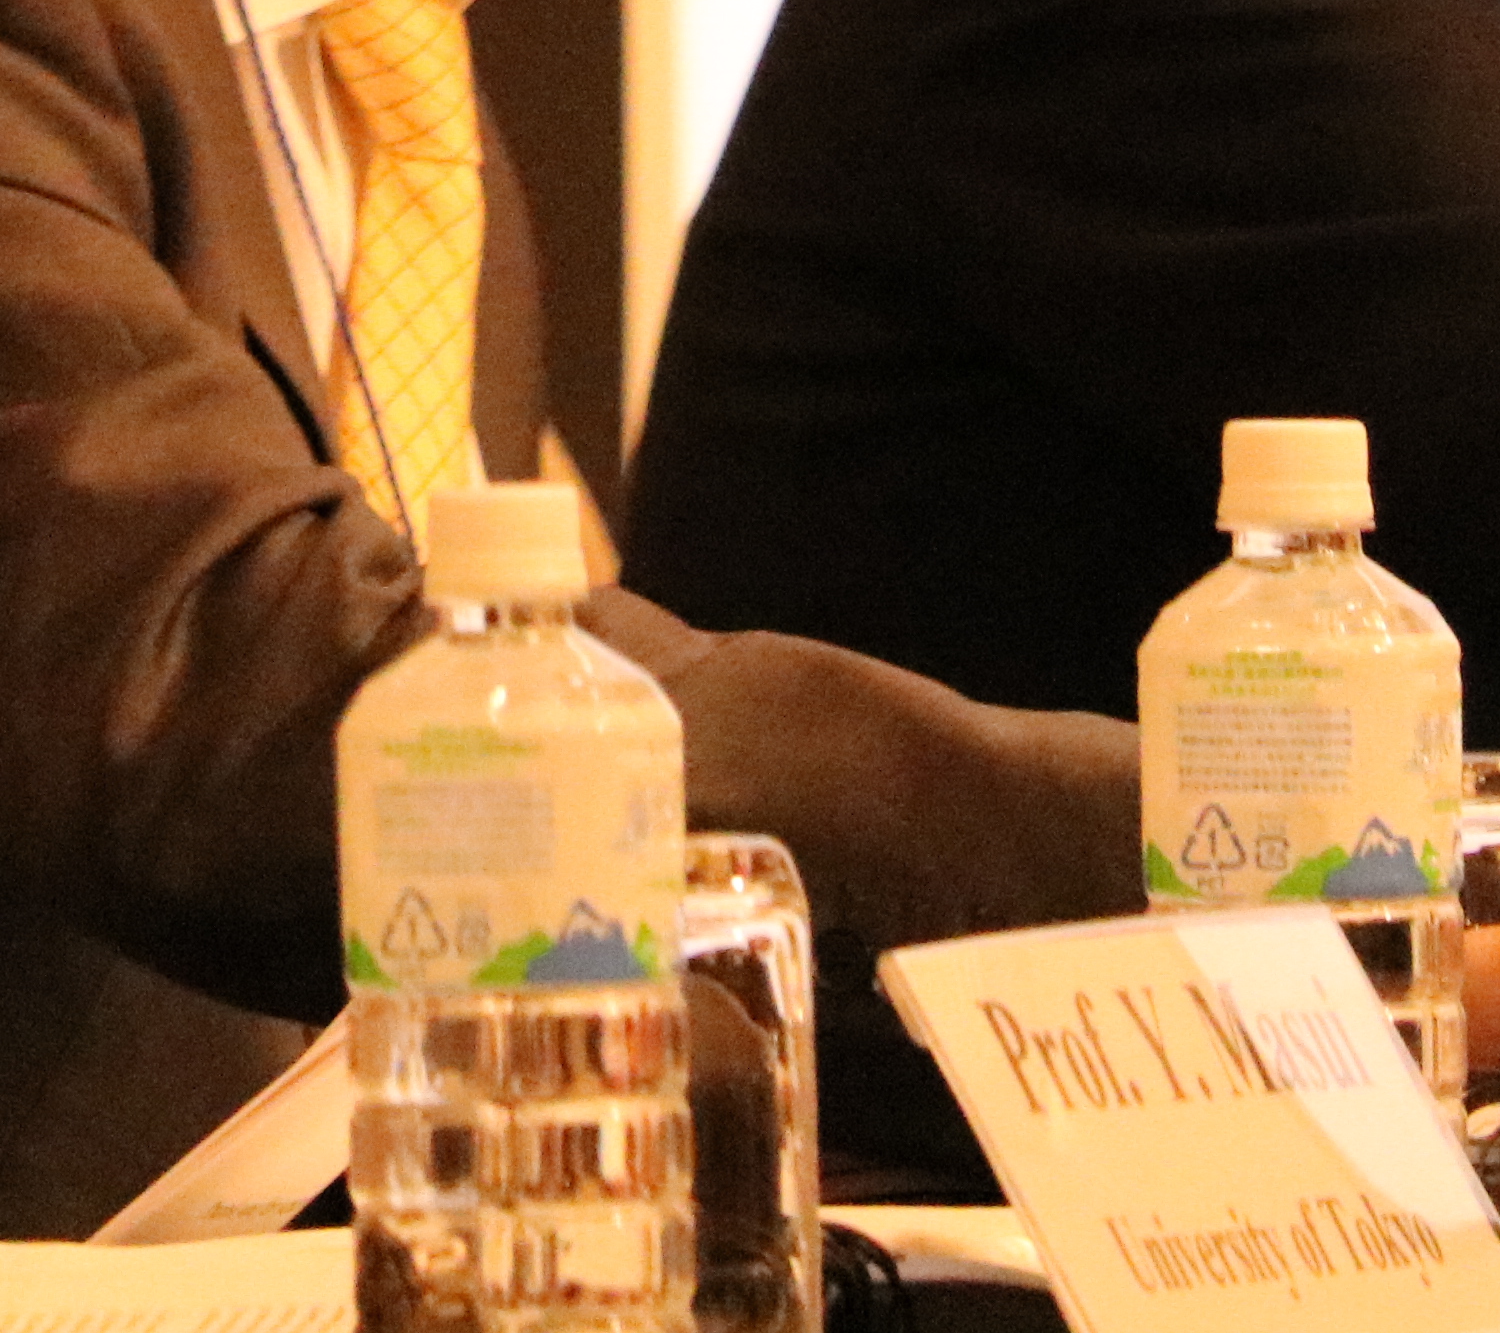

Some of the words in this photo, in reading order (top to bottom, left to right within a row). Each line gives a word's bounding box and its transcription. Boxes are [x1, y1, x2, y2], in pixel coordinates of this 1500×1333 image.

[975, 990, 1145, 1115] Prof.
[1114, 985, 1214, 1103] Y.
[1183, 974, 1375, 1099] Masui
[1105, 1206, 1300, 1301] University
[1289, 1198, 1338, 1279] of
[1316, 1193, 1445, 1290] Tokyo
